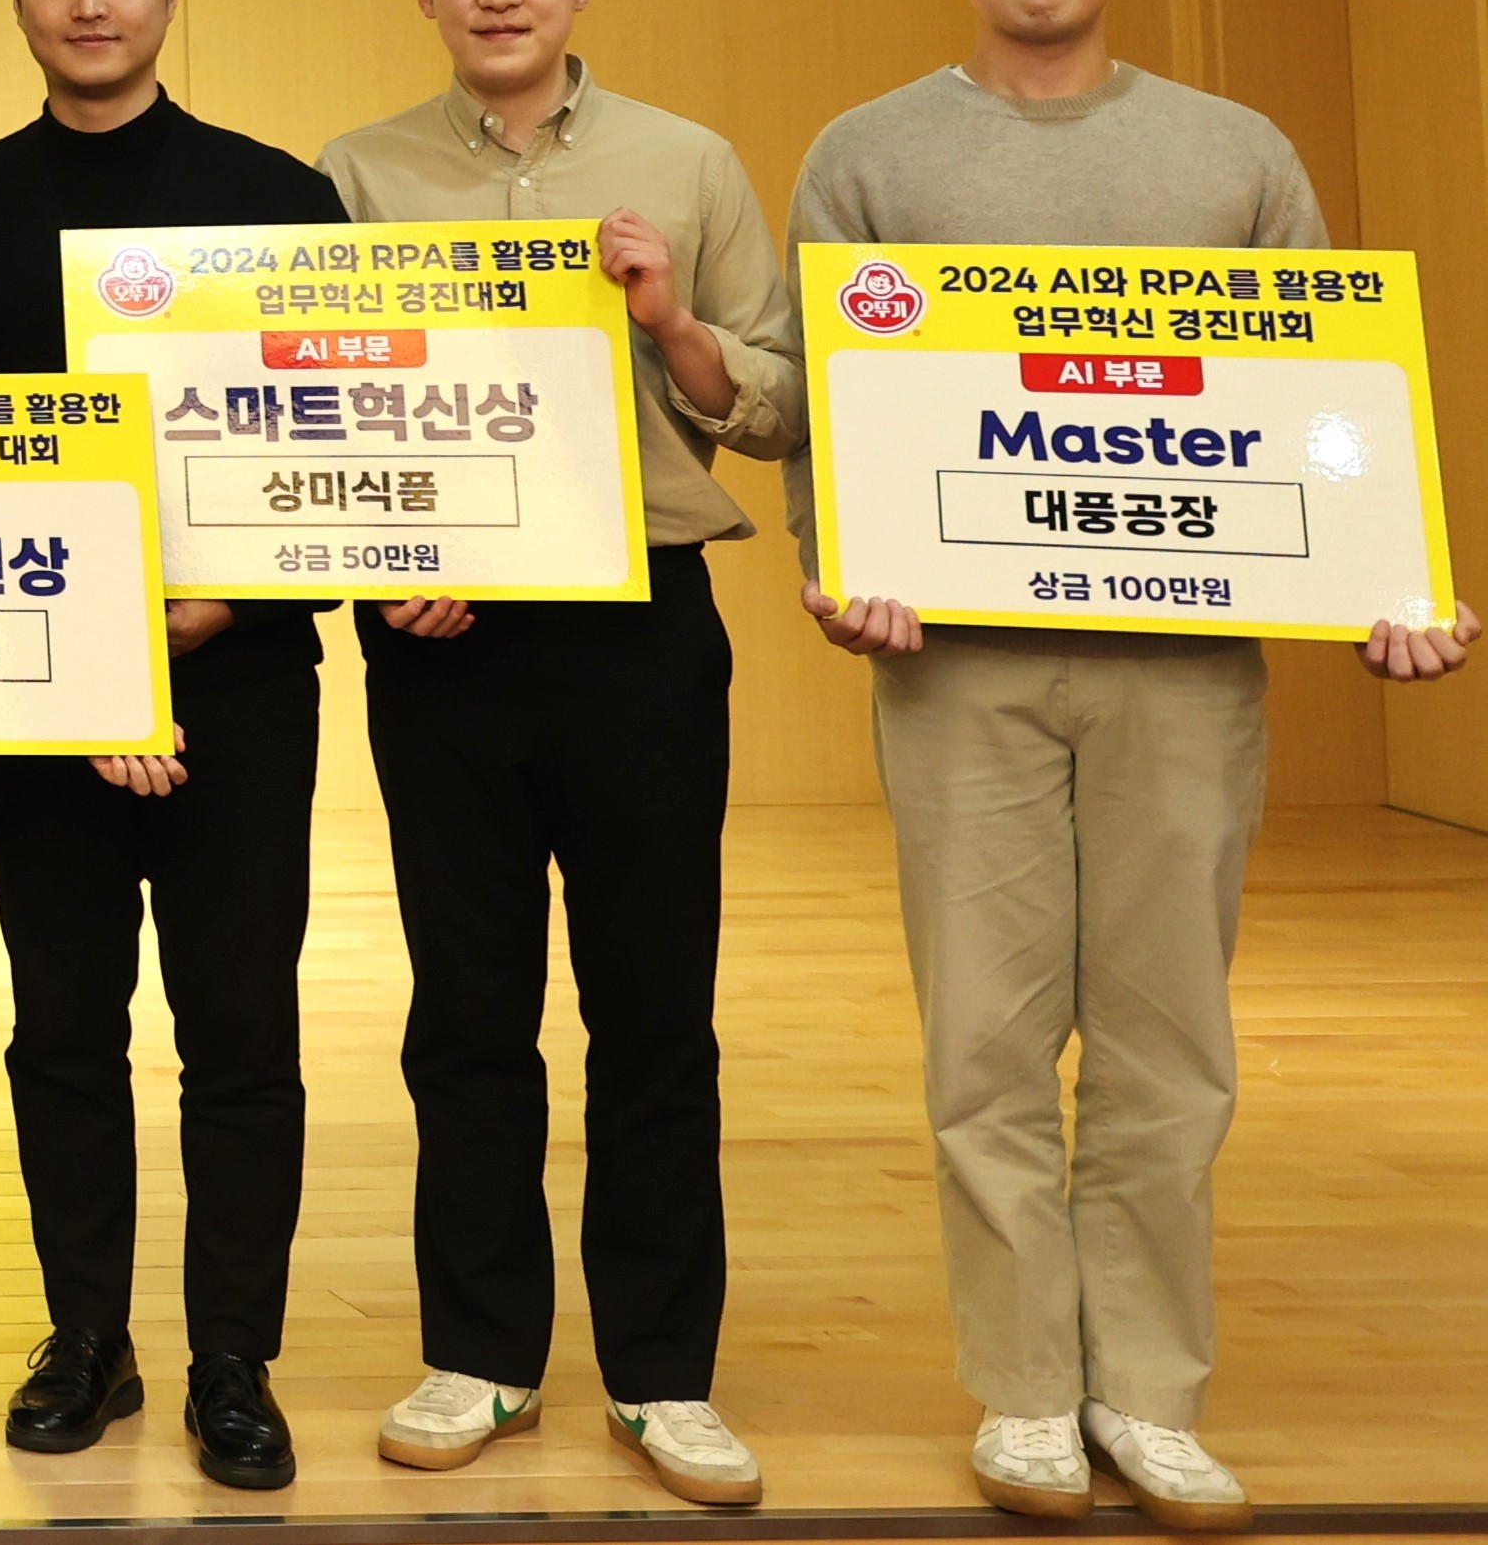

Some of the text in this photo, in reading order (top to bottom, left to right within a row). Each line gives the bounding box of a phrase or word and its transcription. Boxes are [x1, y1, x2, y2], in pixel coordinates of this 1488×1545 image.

[190, 239, 590, 274] 2024 AI와 RPA를 활용한
[113, 282, 160, 303] 오뚜기
[256, 280, 527, 314] 업무혁신 경진대회
[940, 266, 1383, 302] 2024 AI와 RPA를 활용한
[858, 301, 907, 318] 오뚜기
[1014, 306, 1313, 342] 업무혁신 경진대회
[297, 336, 391, 361] AI 부문
[1059, 361, 1163, 388] AI 부문
[26, 393, 121, 424] 활용한
[165, 383, 538, 442] 스마트혁신상
[979, 410, 1261, 467] Master
[263, 471, 438, 512] 상미식품
[1025, 490, 1217, 538] 대풍공장
[275, 545, 439, 572] 상금 50만원
[1029, 572, 1231, 606] 상금 100만원
